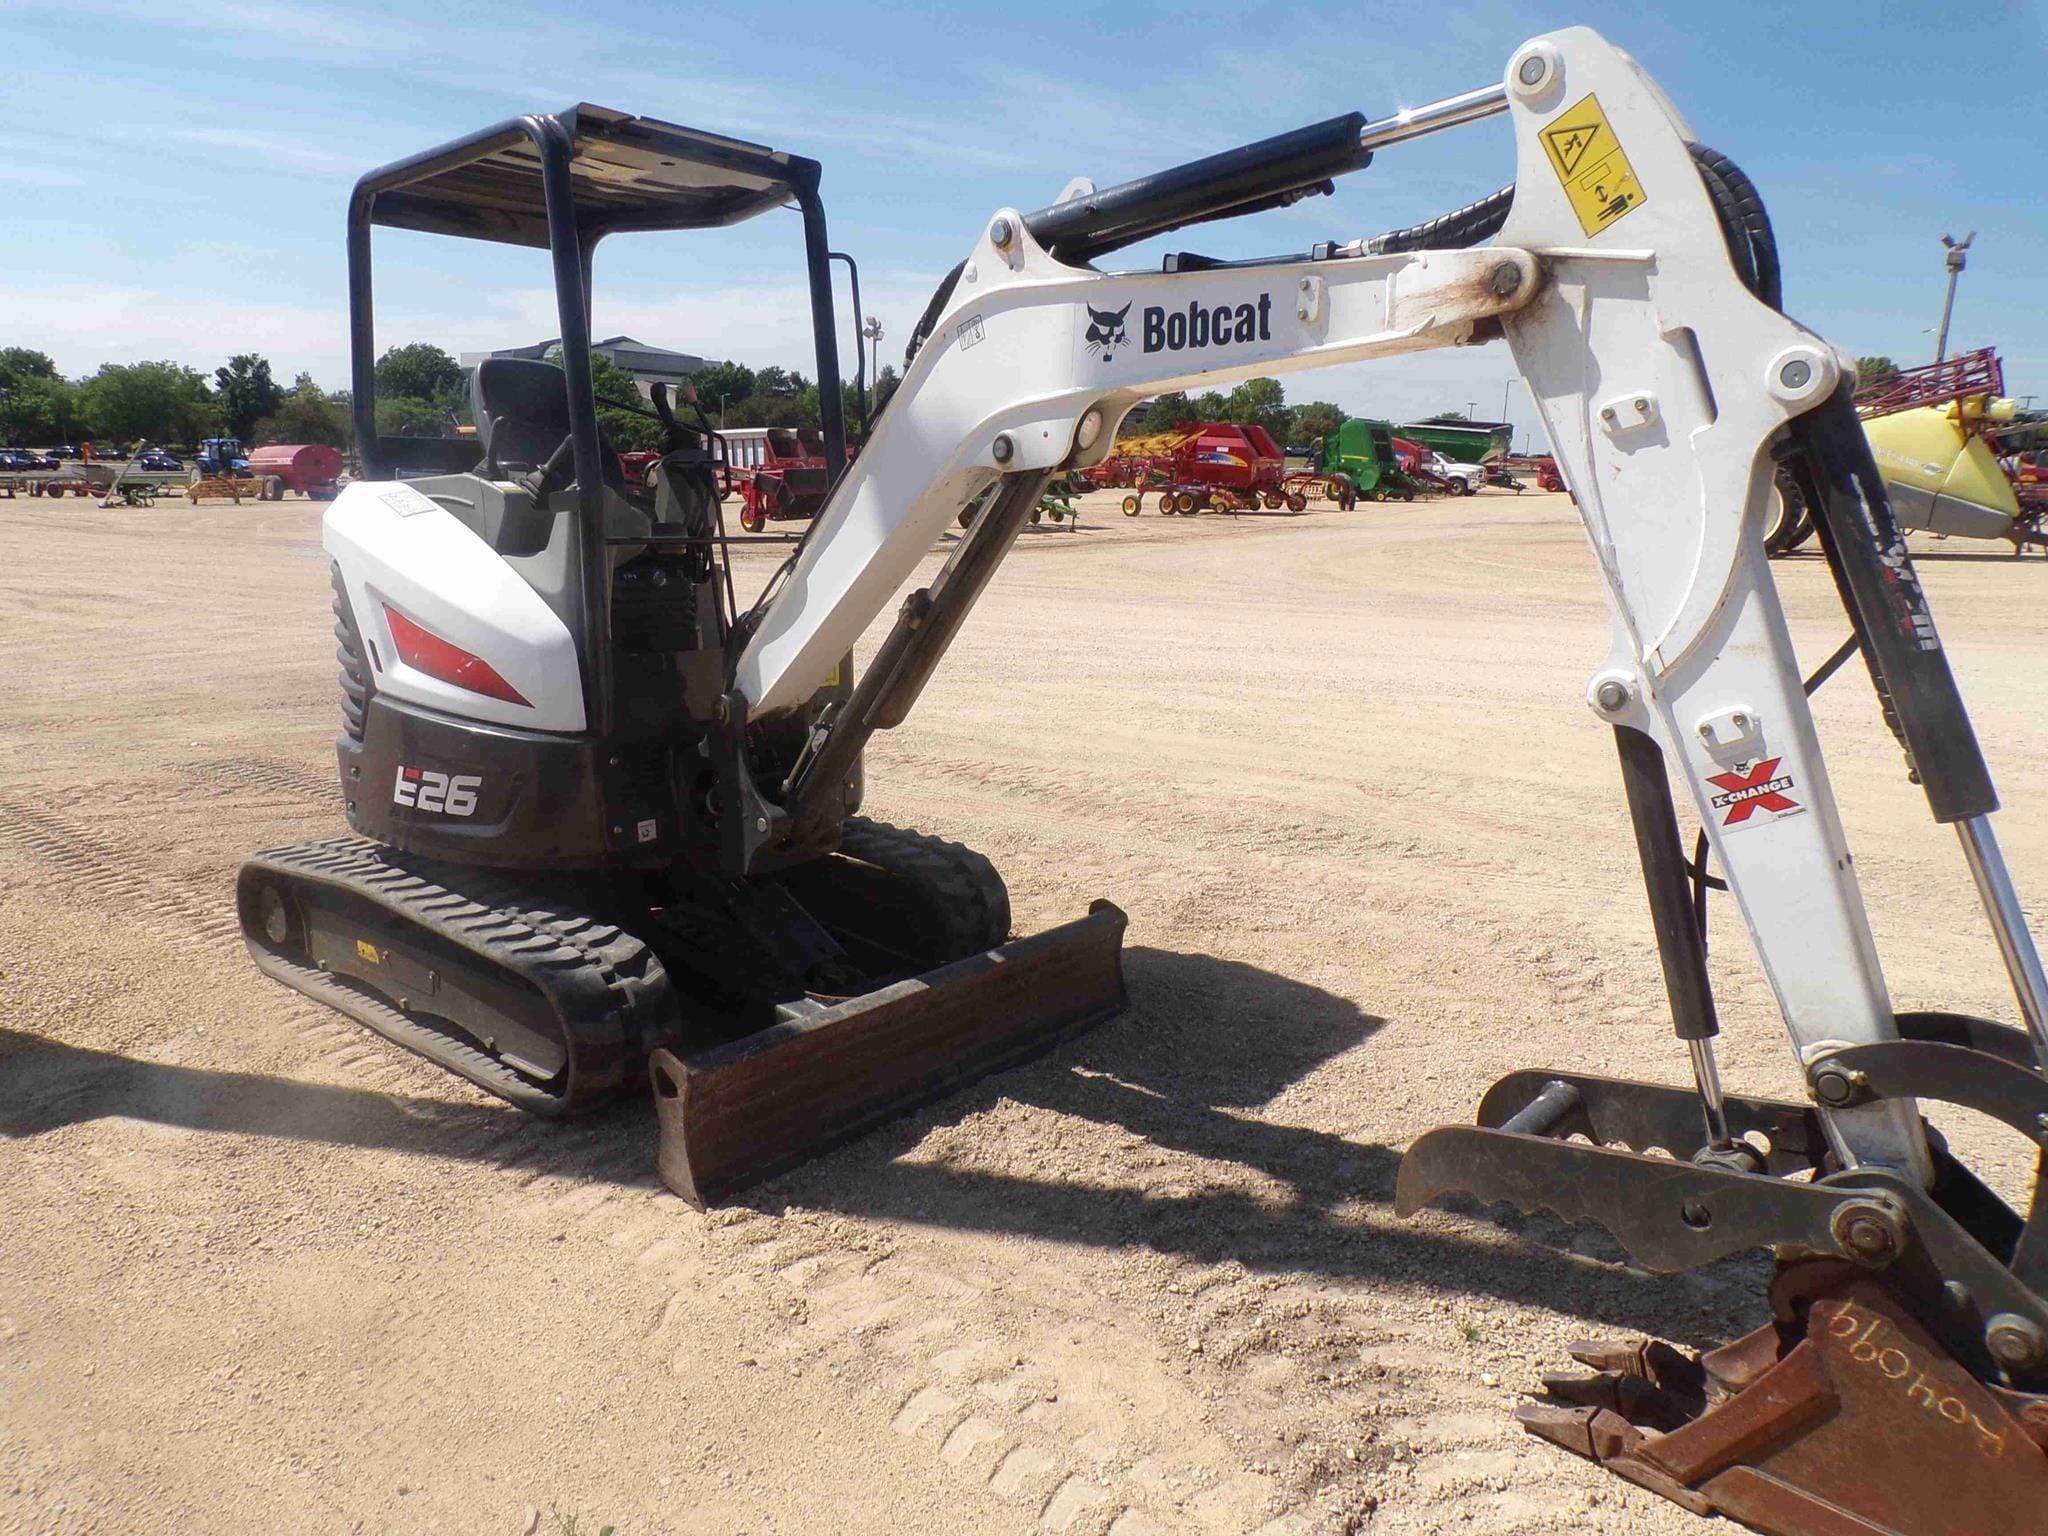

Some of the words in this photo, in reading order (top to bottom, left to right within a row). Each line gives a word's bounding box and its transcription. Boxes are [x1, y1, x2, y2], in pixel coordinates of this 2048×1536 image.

[1143, 293, 1271, 353] Bobcat
[394, 766, 482, 816] E26
[1712, 777, 1792, 808] X-CHANGE
